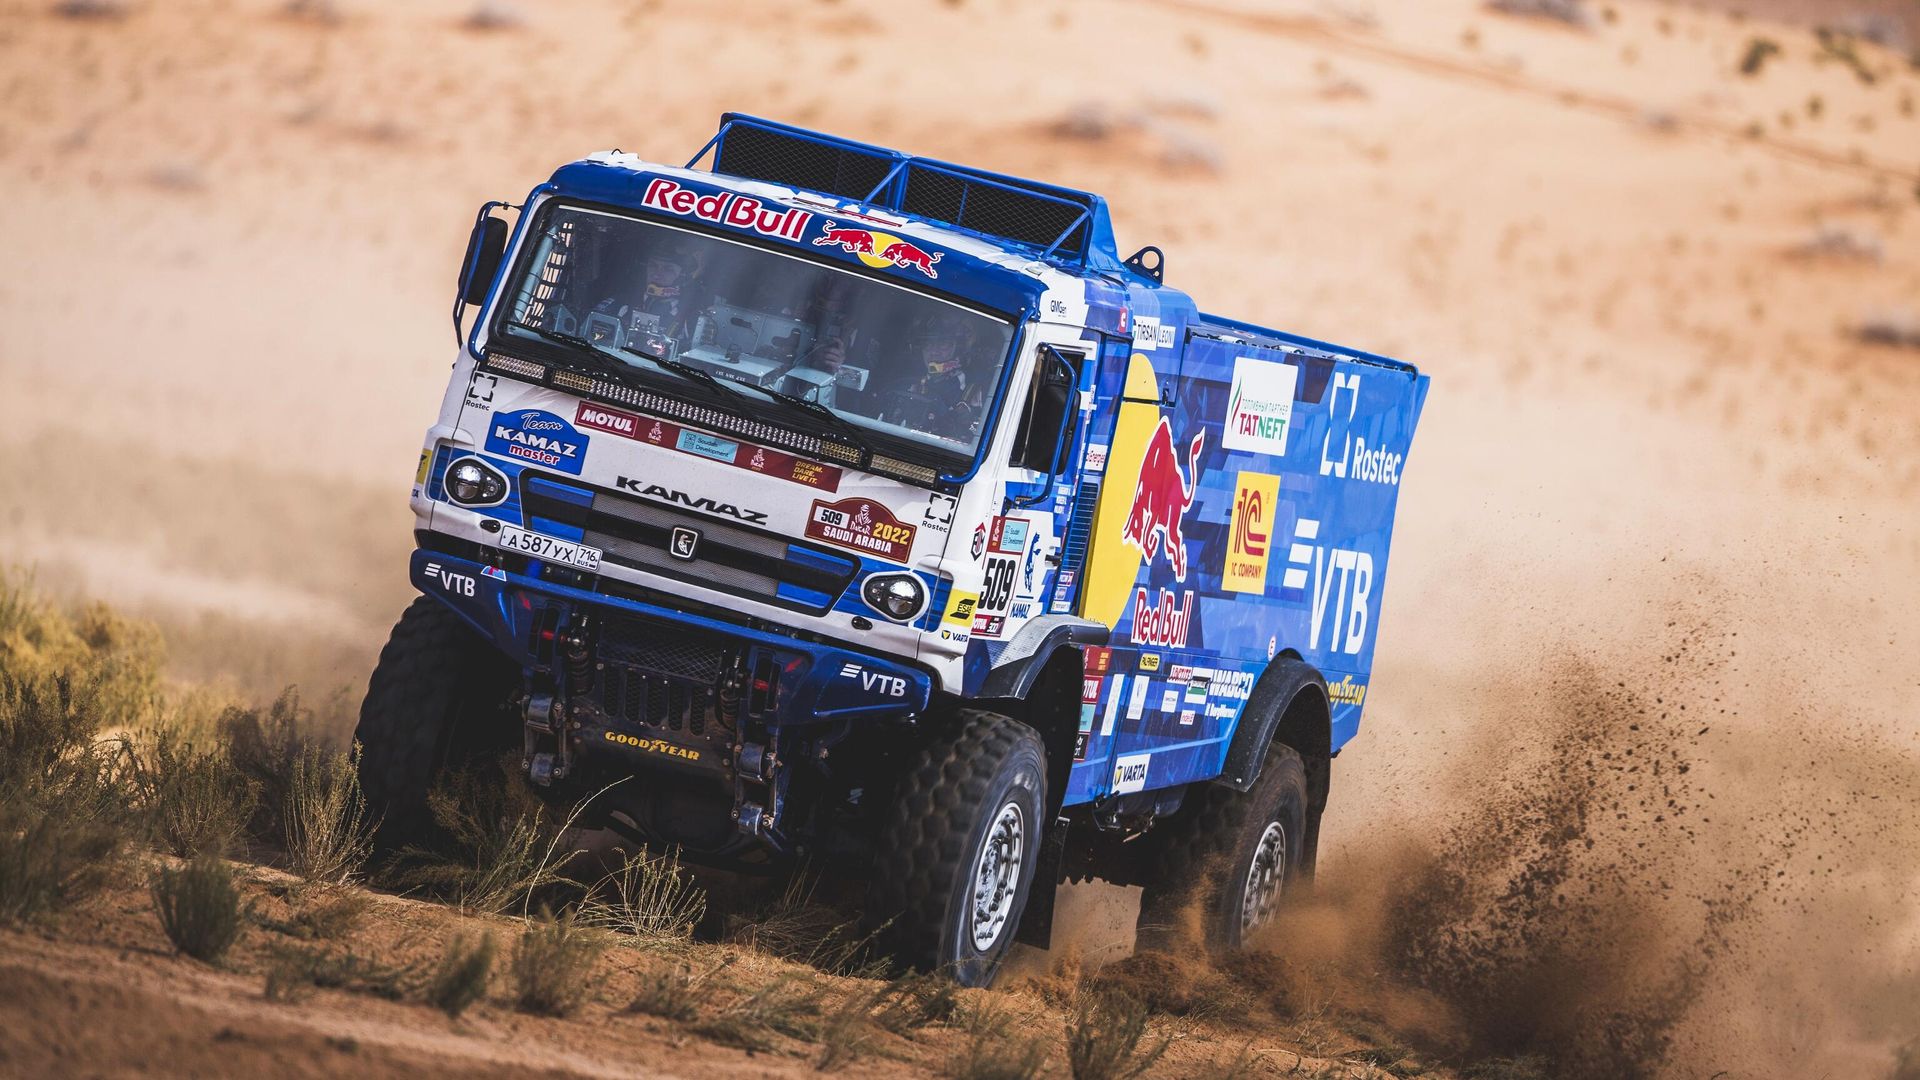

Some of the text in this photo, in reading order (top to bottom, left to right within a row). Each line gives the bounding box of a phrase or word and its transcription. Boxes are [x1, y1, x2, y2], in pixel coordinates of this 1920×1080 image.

[642, 178, 814, 243] Red Bull
[465, 399, 490, 411] Rostec
[521, 412, 563, 431] Team
[581, 409, 632, 431] MOTUL
[1239, 412, 1286, 441] TATNEFT
[495, 426, 577, 457] KAMAZ
[509, 445, 560, 465] master
[1351, 437, 1401, 486] Rostec
[616, 476, 768, 526] KAMAZ
[820, 509, 843, 526] 509
[921, 520, 948, 533] Rostec
[822, 525, 892, 553] SAUDI ARABIA
[872, 522, 910, 545] 2022
[441, 570, 476, 597] VTB
[977, 558, 1016, 611] 509
[1238, 564, 1262, 579] COMPANY
[1309, 546, 1374, 655] VTB
[862, 671, 907, 697] VTB
[604, 730, 700, 761] GOODYEAR
[1122, 763, 1146, 783] VARTA
